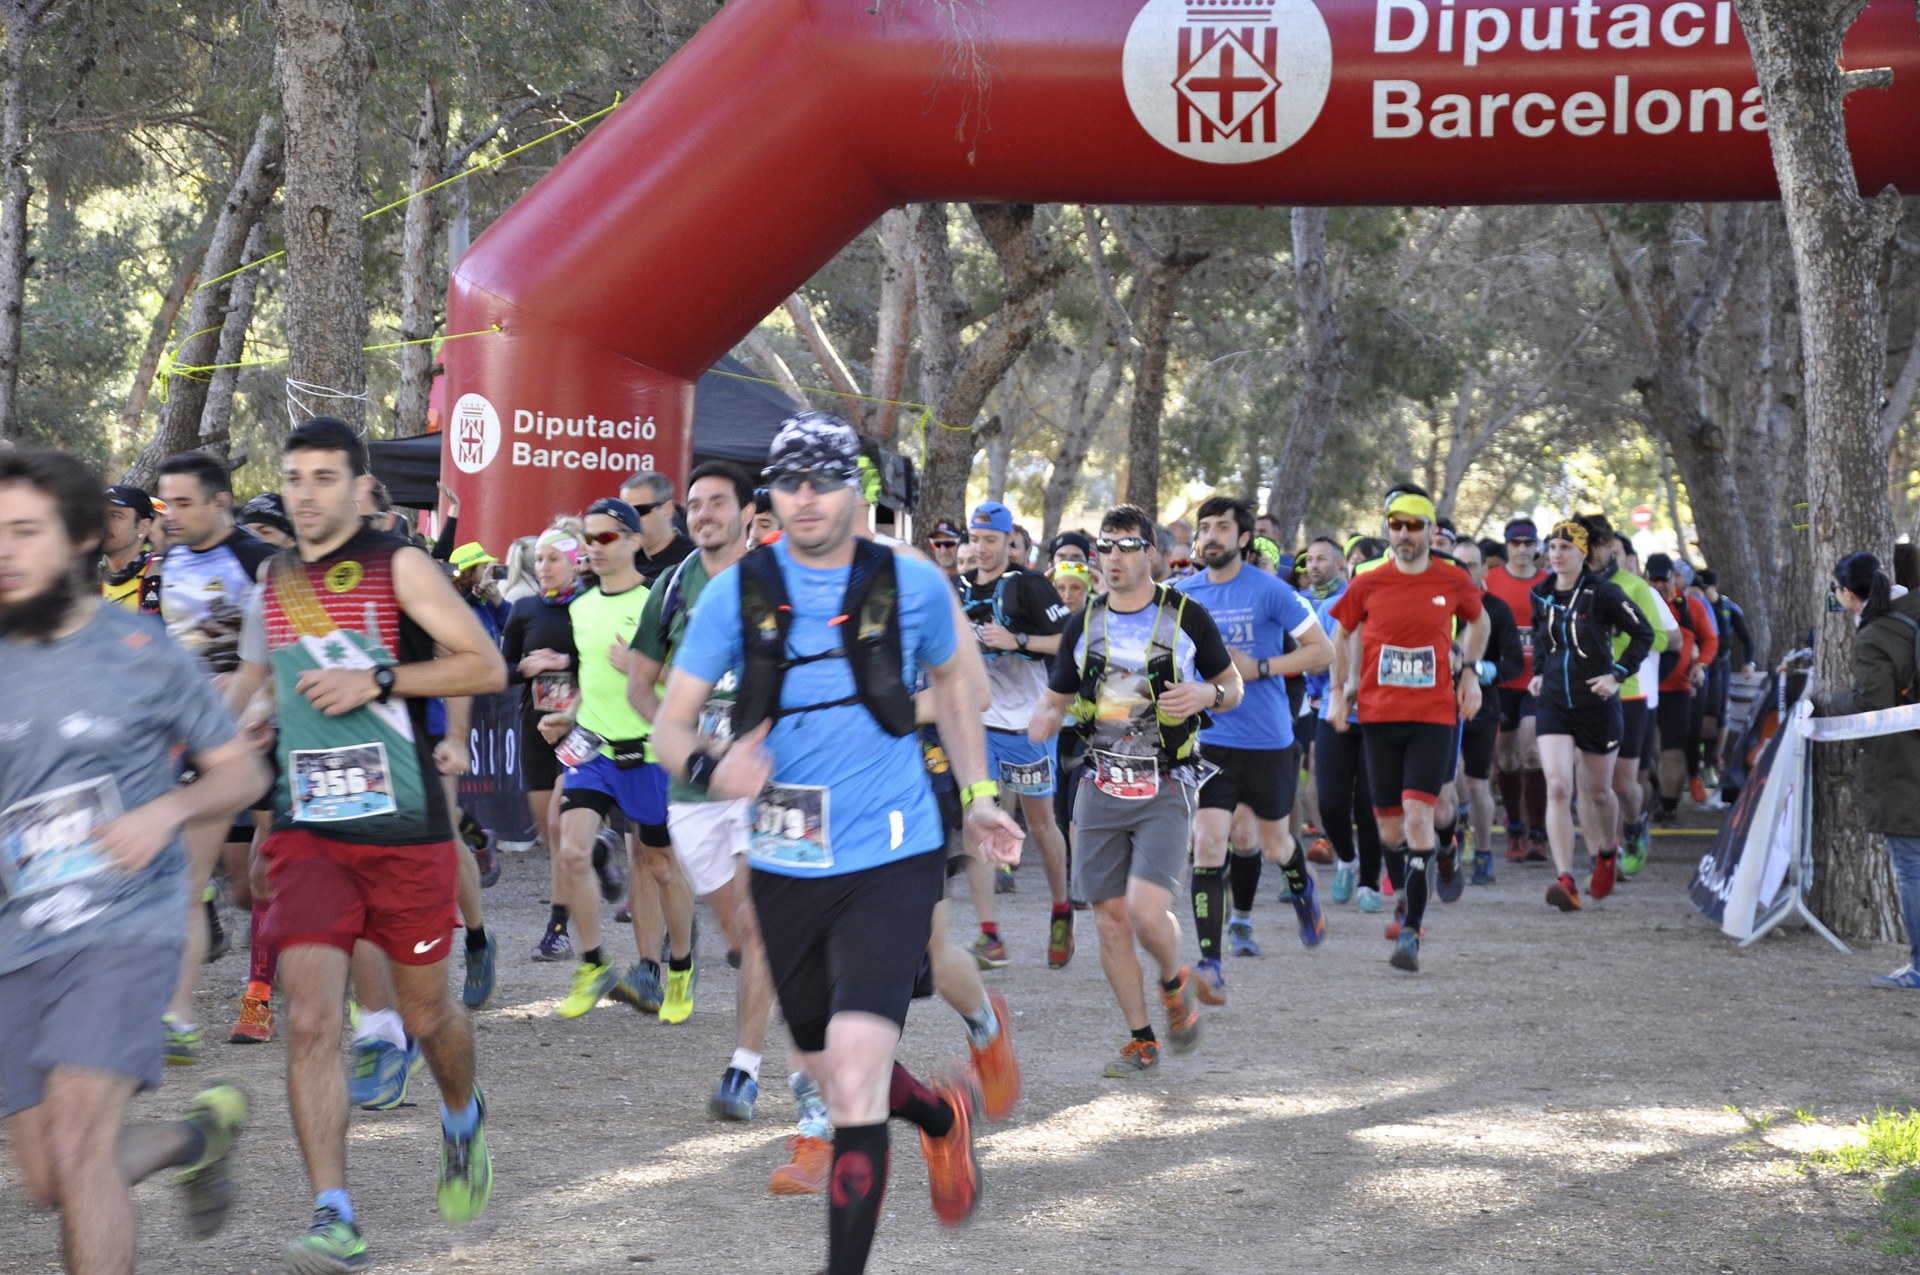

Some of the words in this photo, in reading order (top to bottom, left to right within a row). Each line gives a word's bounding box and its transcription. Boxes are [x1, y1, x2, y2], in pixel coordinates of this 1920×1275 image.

[1374, 0, 1731, 66] Diputaci
[1372, 75, 1769, 139] Barcelona
[513, 409, 657, 441] Diputació
[511, 441, 655, 472] Barcelona
[1392, 659, 1423, 673] 302
[308, 767, 368, 798] 356
[1011, 770, 1042, 785] 508
[1110, 766, 1135, 784] 91
